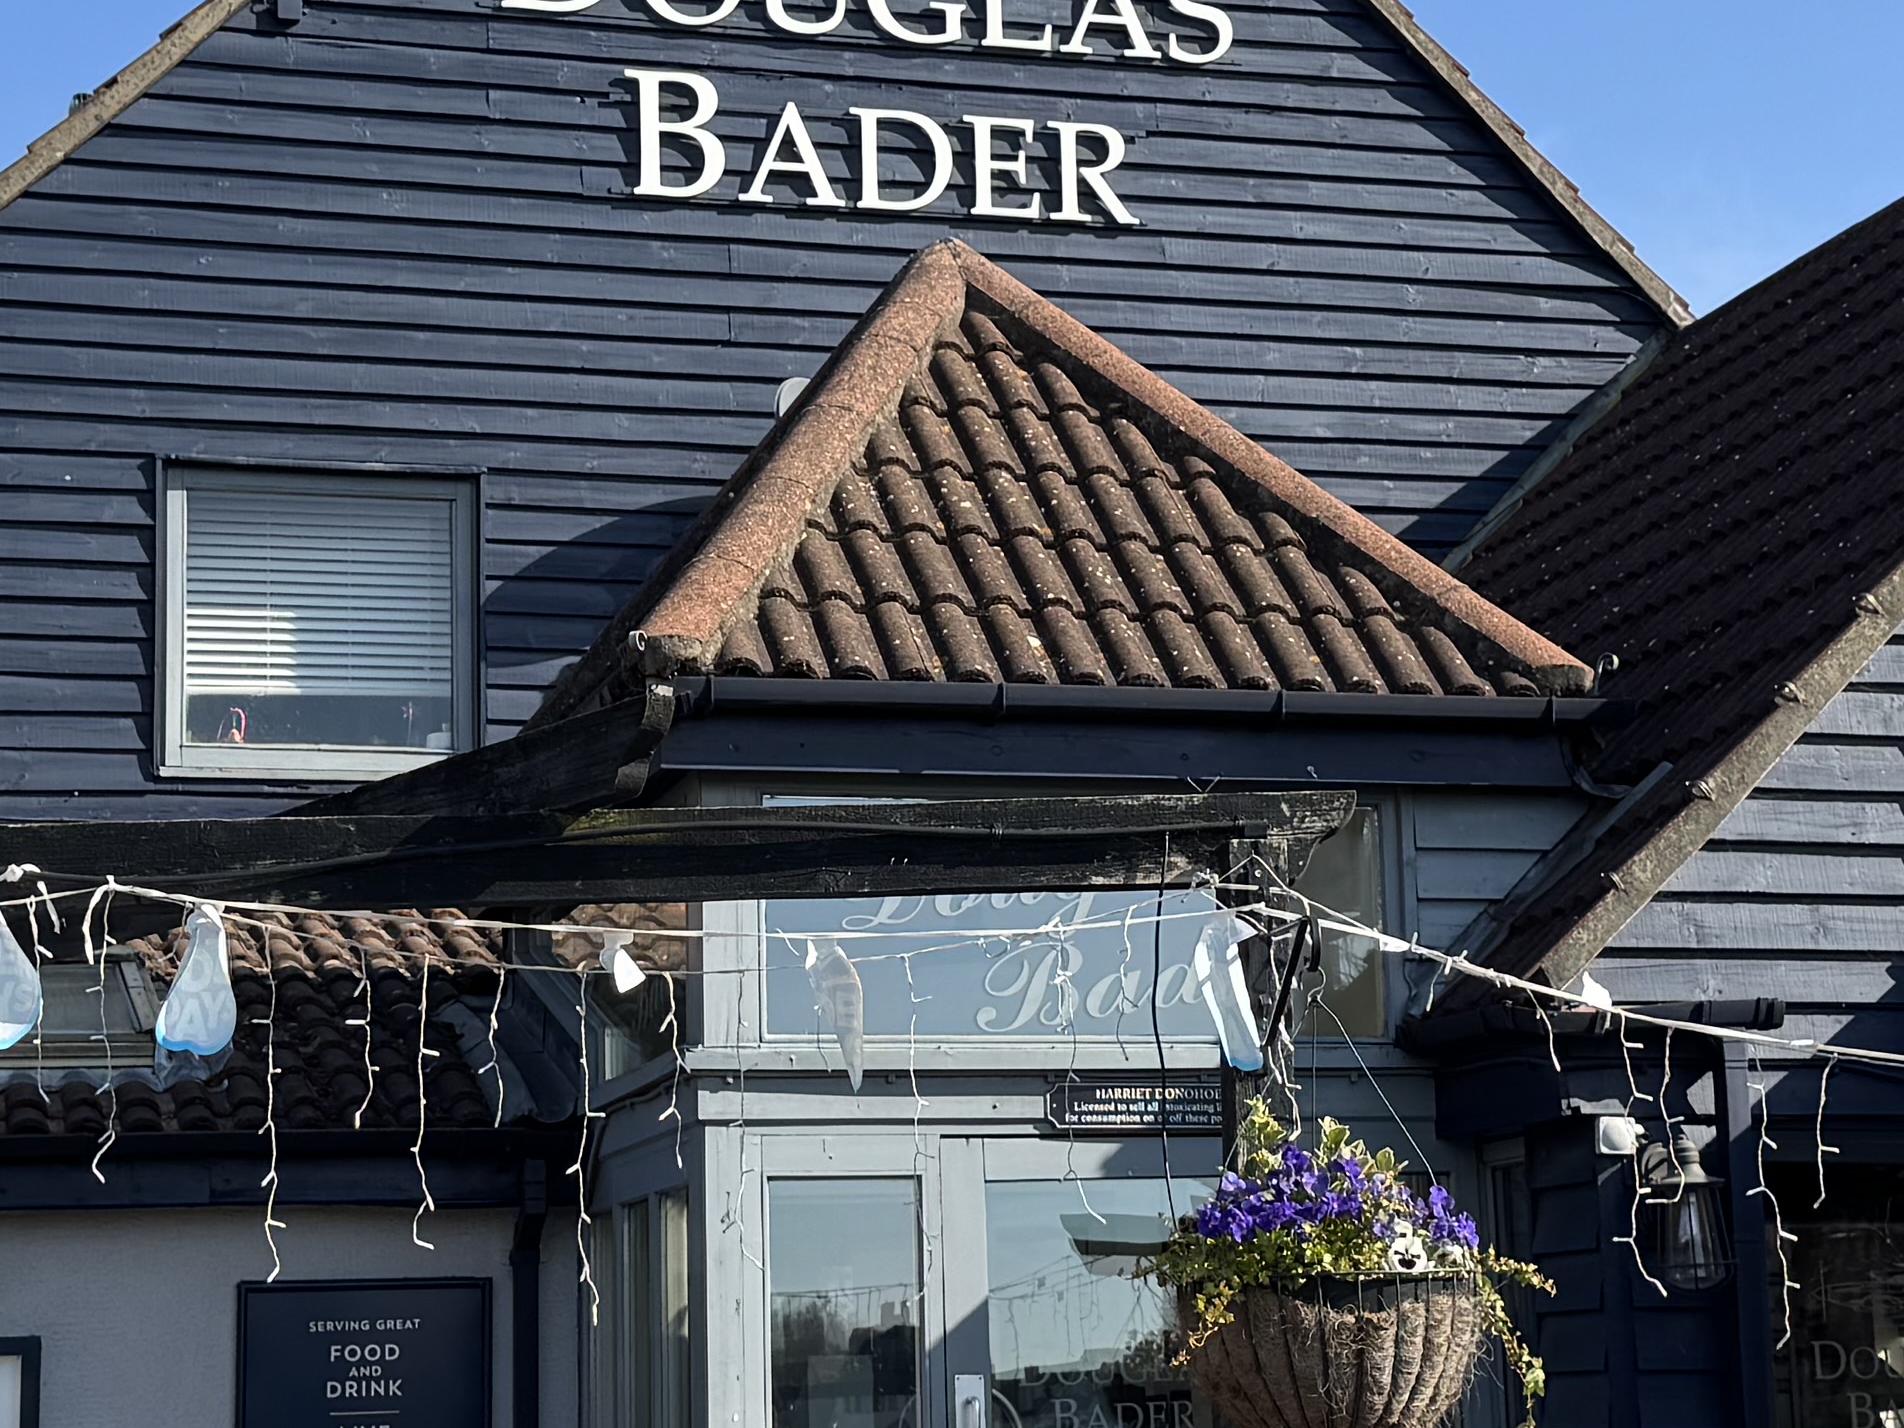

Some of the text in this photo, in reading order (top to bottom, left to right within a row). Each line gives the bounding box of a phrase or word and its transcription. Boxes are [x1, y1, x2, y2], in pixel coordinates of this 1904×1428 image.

[622, 68, 1144, 227] BADER
[1096, 1088, 1152, 1099] HARRIET
[1074, 1101, 1115, 1112] Licensed
[1117, 1103, 1127, 1112] to
[1129, 1101, 1145, 1112] sell
[1147, 1101, 1159, 1112] all
[1065, 1113, 1079, 1123] for
[1081, 1113, 1141, 1125] consumption
[1143, 1114, 1155, 1123] on
[308, 1318, 421, 1333] SERVING GREAT
[330, 1343, 401, 1363] FOOD
[349, 1365, 382, 1378] AND
[326, 1379, 403, 1399] DRINK
